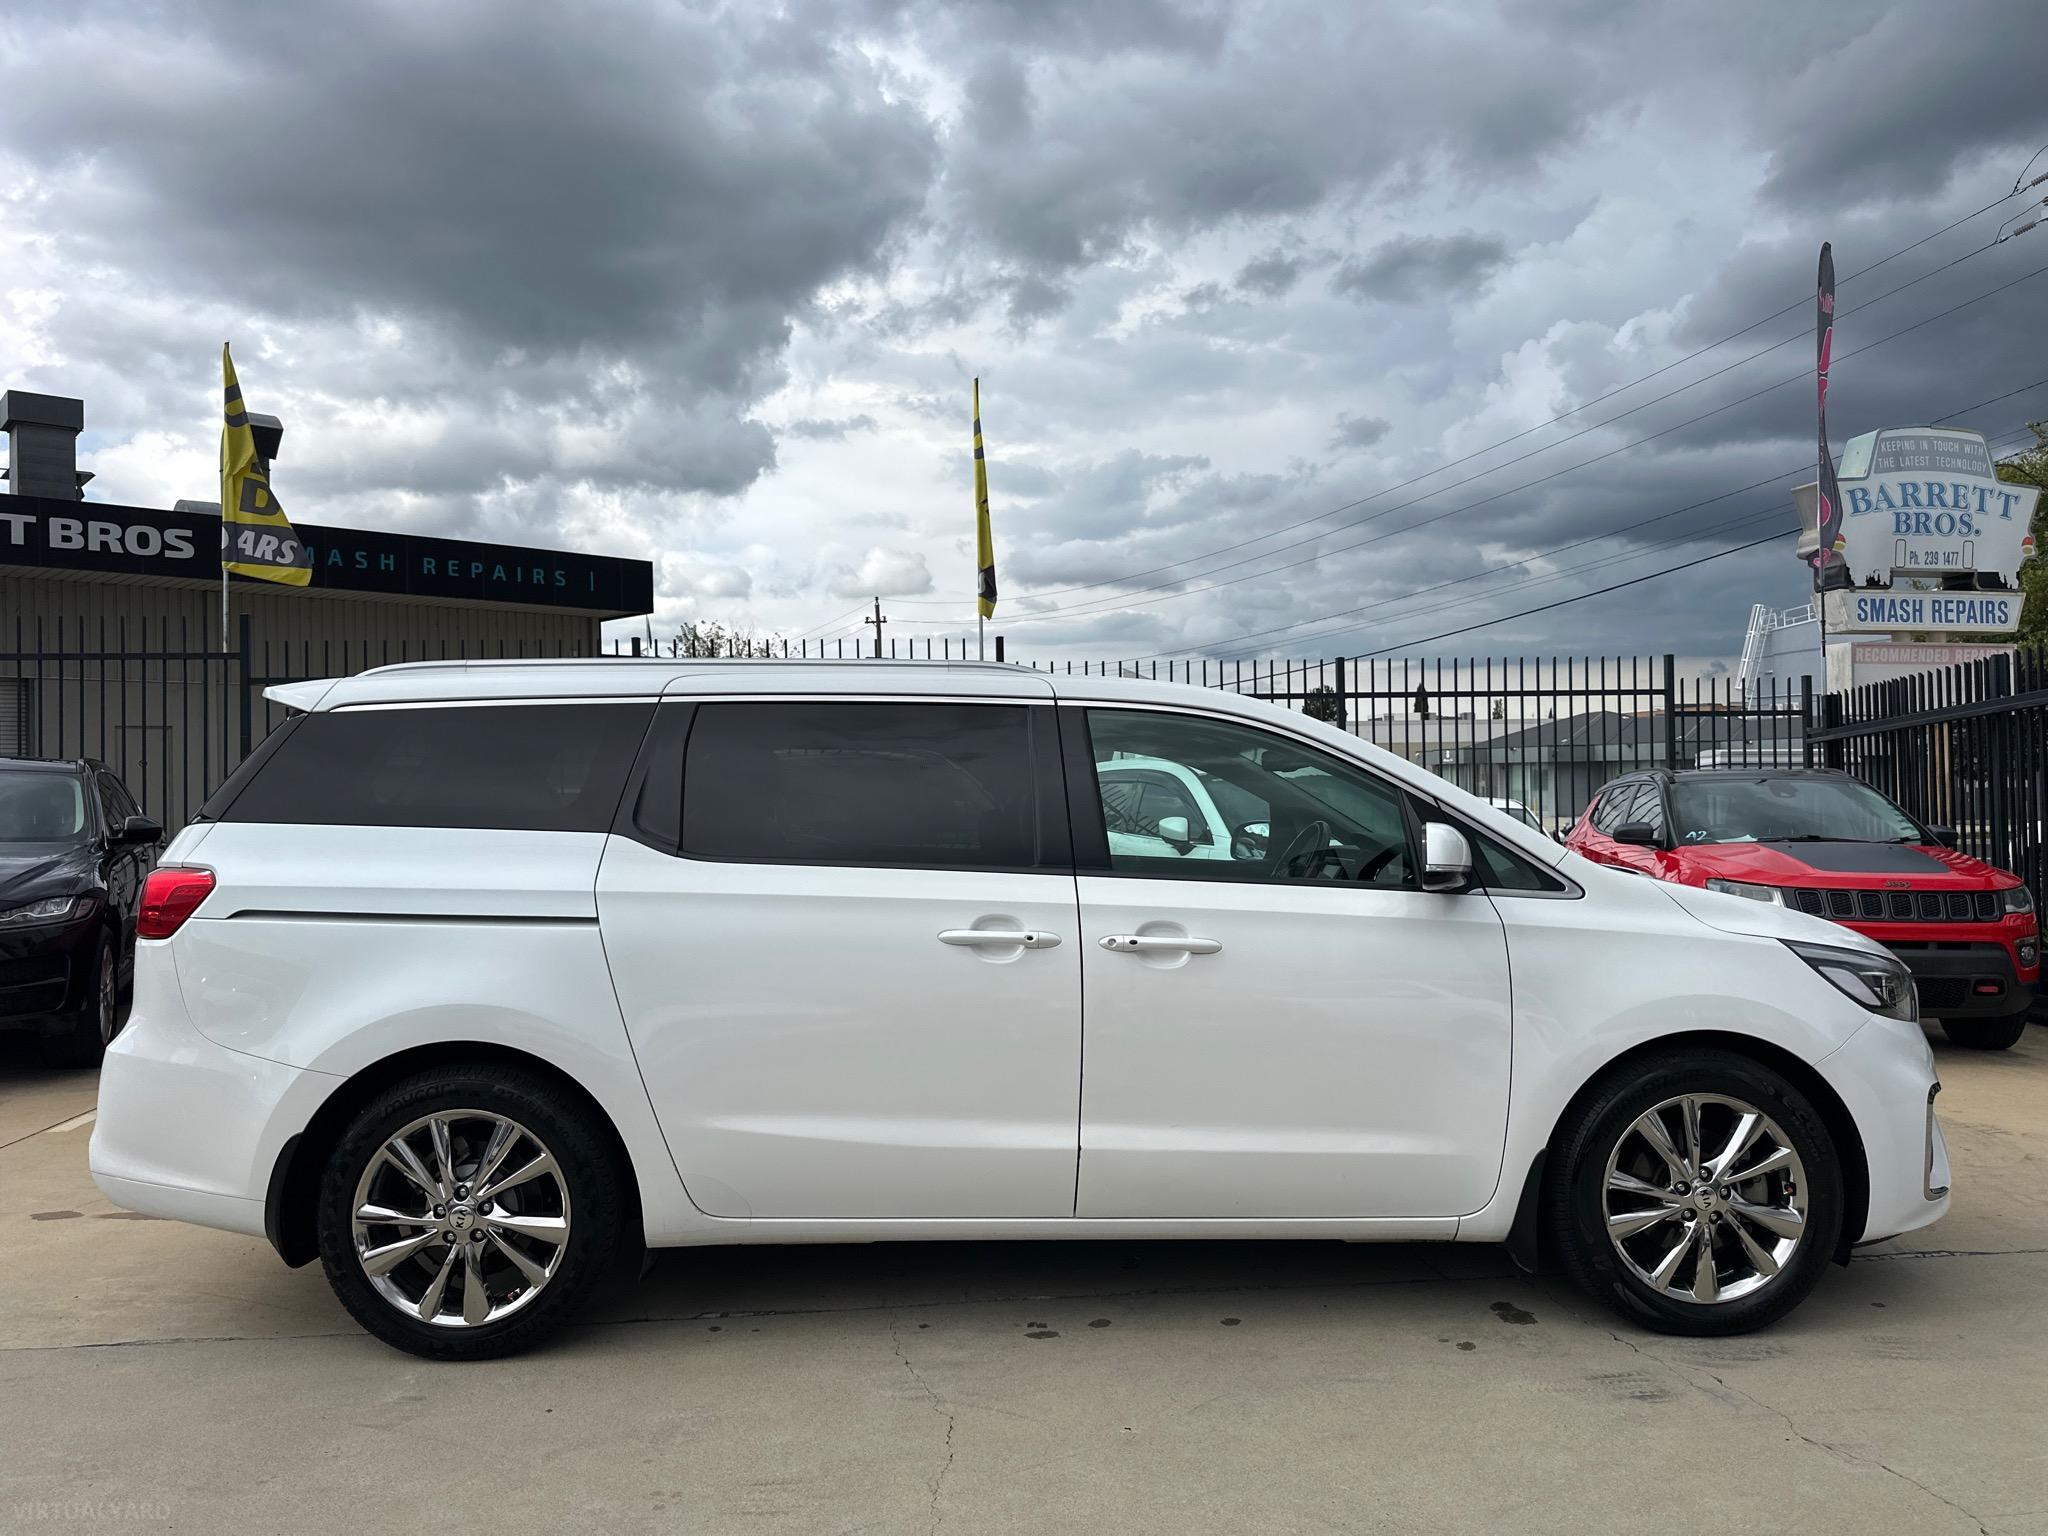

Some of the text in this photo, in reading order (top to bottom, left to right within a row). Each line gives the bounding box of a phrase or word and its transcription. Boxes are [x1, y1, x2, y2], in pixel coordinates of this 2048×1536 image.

[1880, 439, 1984, 457] KEEPING IN TOUCH WITH
[1879, 455, 1987, 473] THE LATEST TECHNOLOGY
[1845, 481, 2021, 520] BARRETT
[1892, 511, 1981, 537] BROS.
[49, 516, 195, 559] BROS
[303, 546, 567, 586] MASH REPAIRS
[1909, 551, 1959, 566] Ph. 239 1477
[1857, 597, 2009, 625] SMASH REPAIRS
[1855, 647, 1951, 663] RECOMMENDED
[1700, 1190, 1711, 1208] KIA
[455, 1209, 468, 1228] KIA
